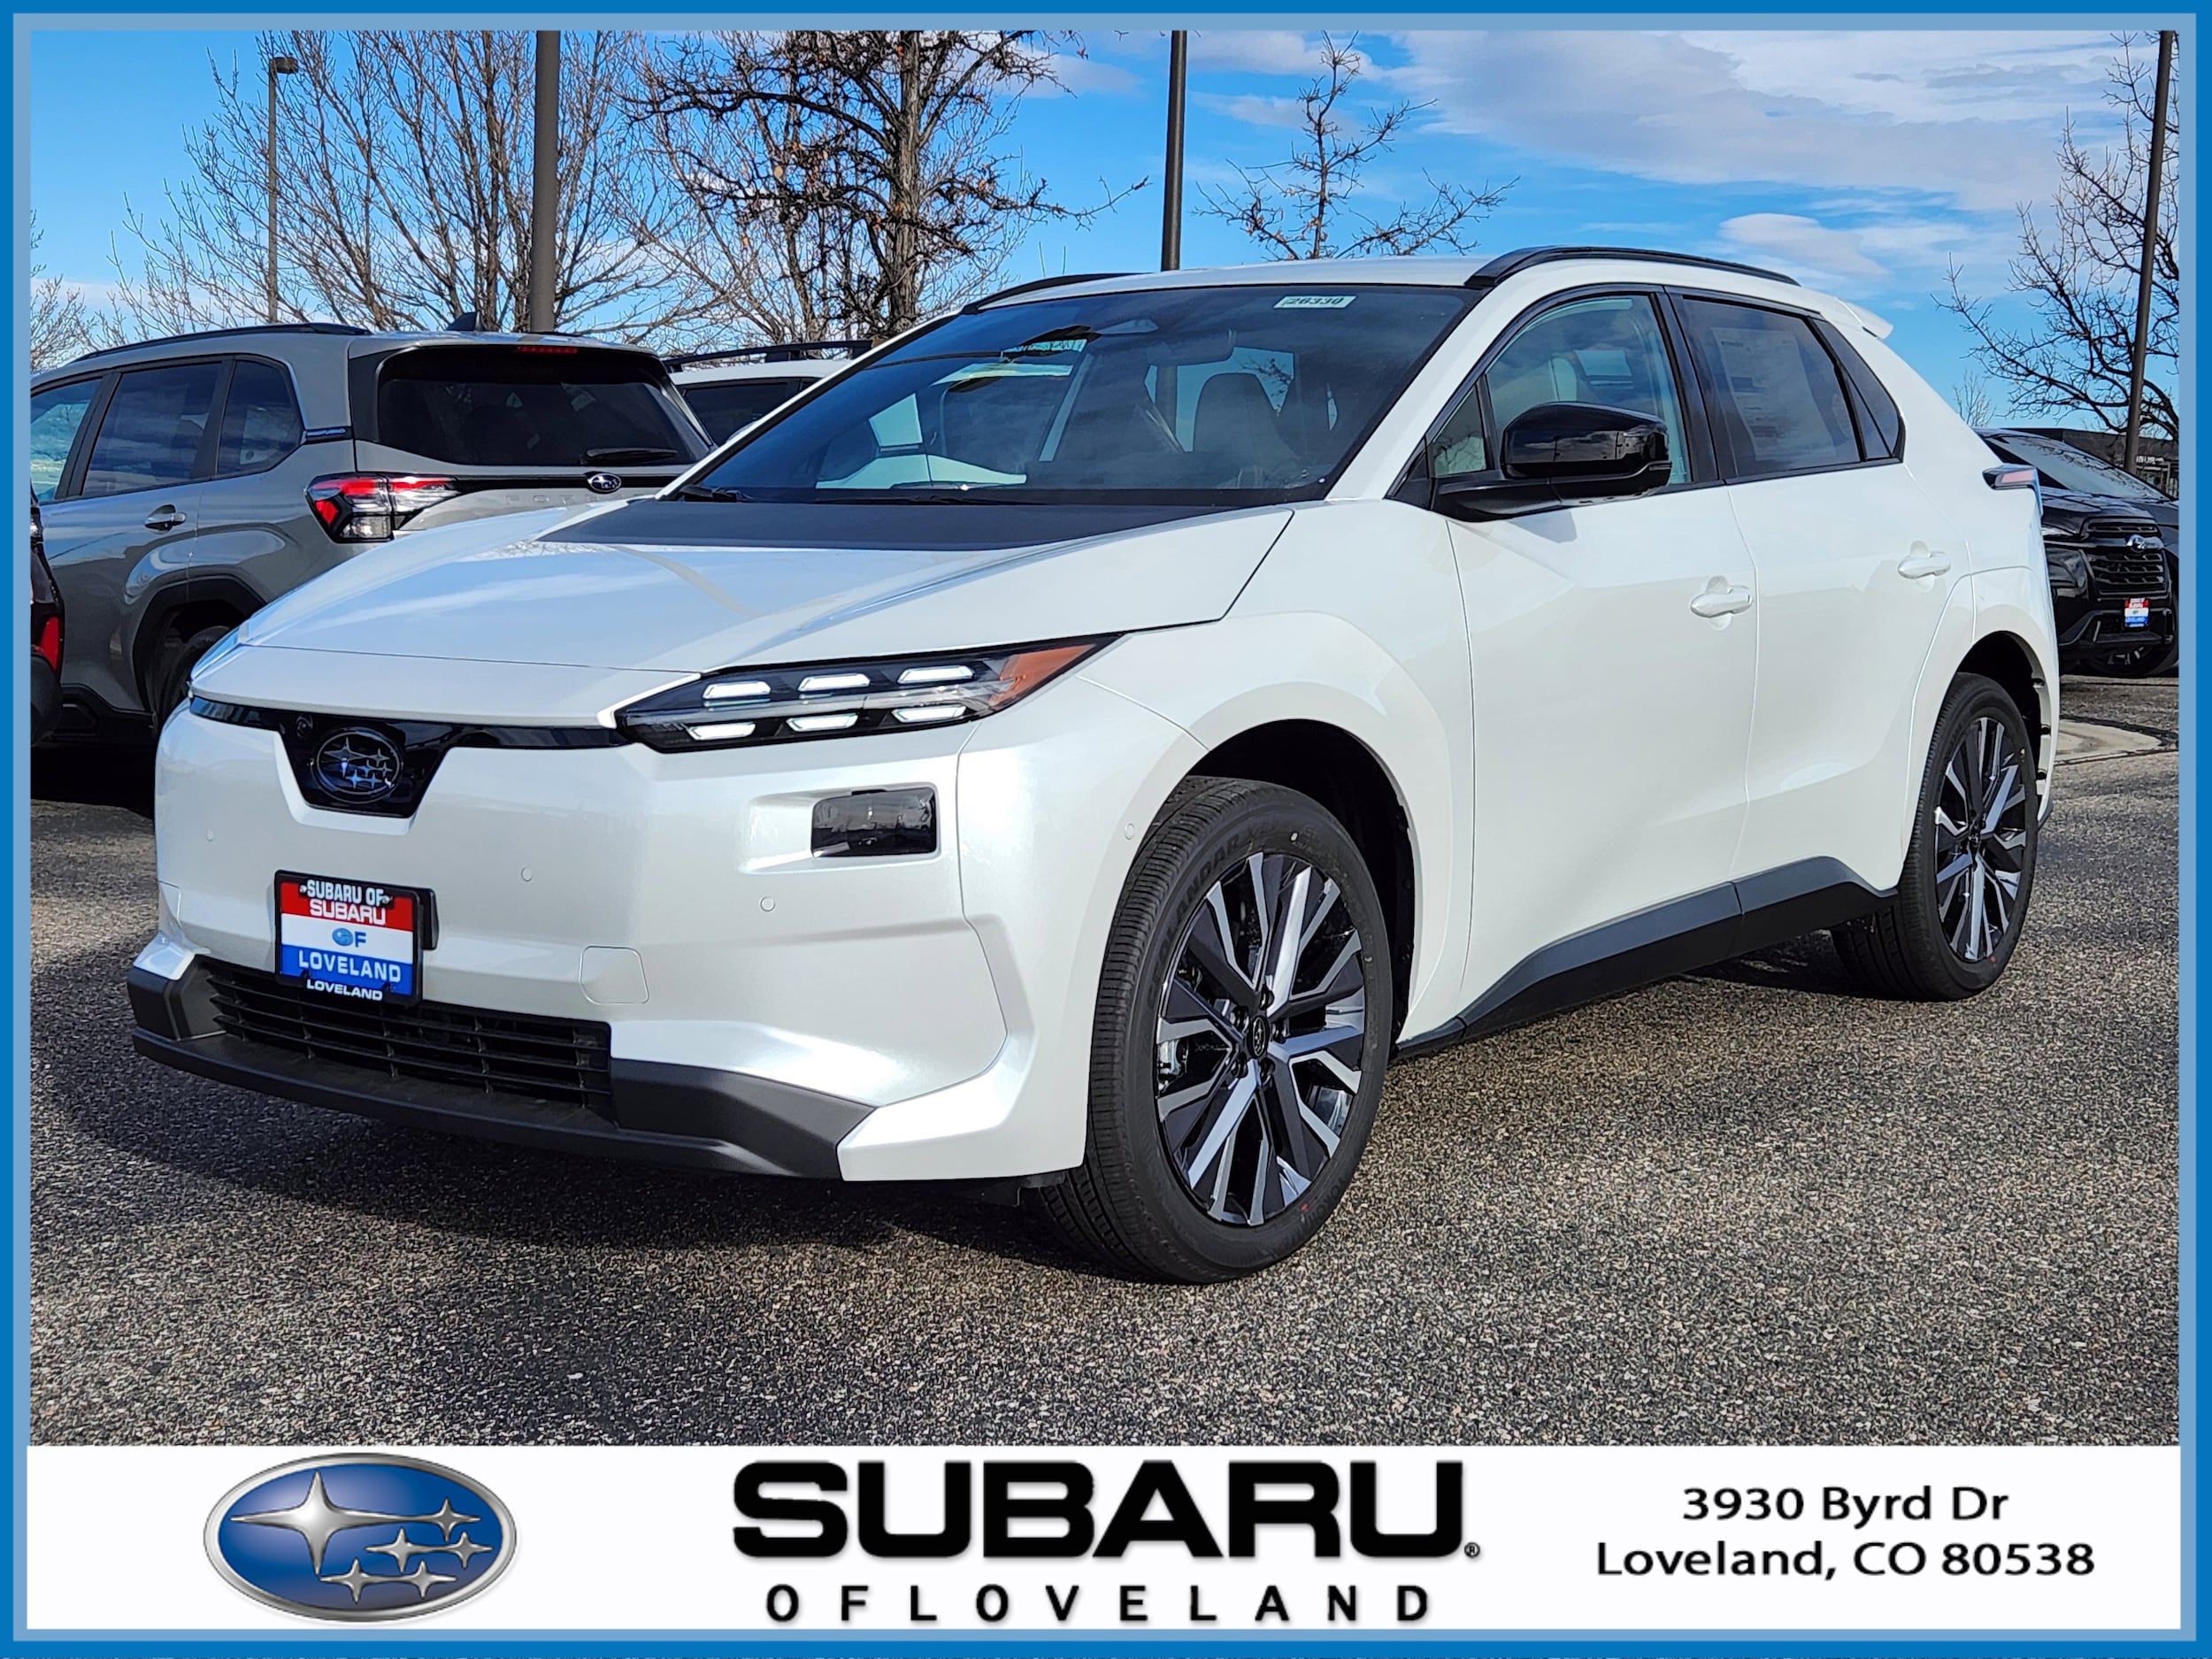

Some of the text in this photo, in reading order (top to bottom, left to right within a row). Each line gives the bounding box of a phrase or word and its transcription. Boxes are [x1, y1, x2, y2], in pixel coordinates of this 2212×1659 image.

[307, 879, 363, 903] SUBARU
[310, 898, 386, 926] SUBARU
[299, 949, 401, 982] LOVELAND
[306, 979, 382, 1001] LOVELAND
